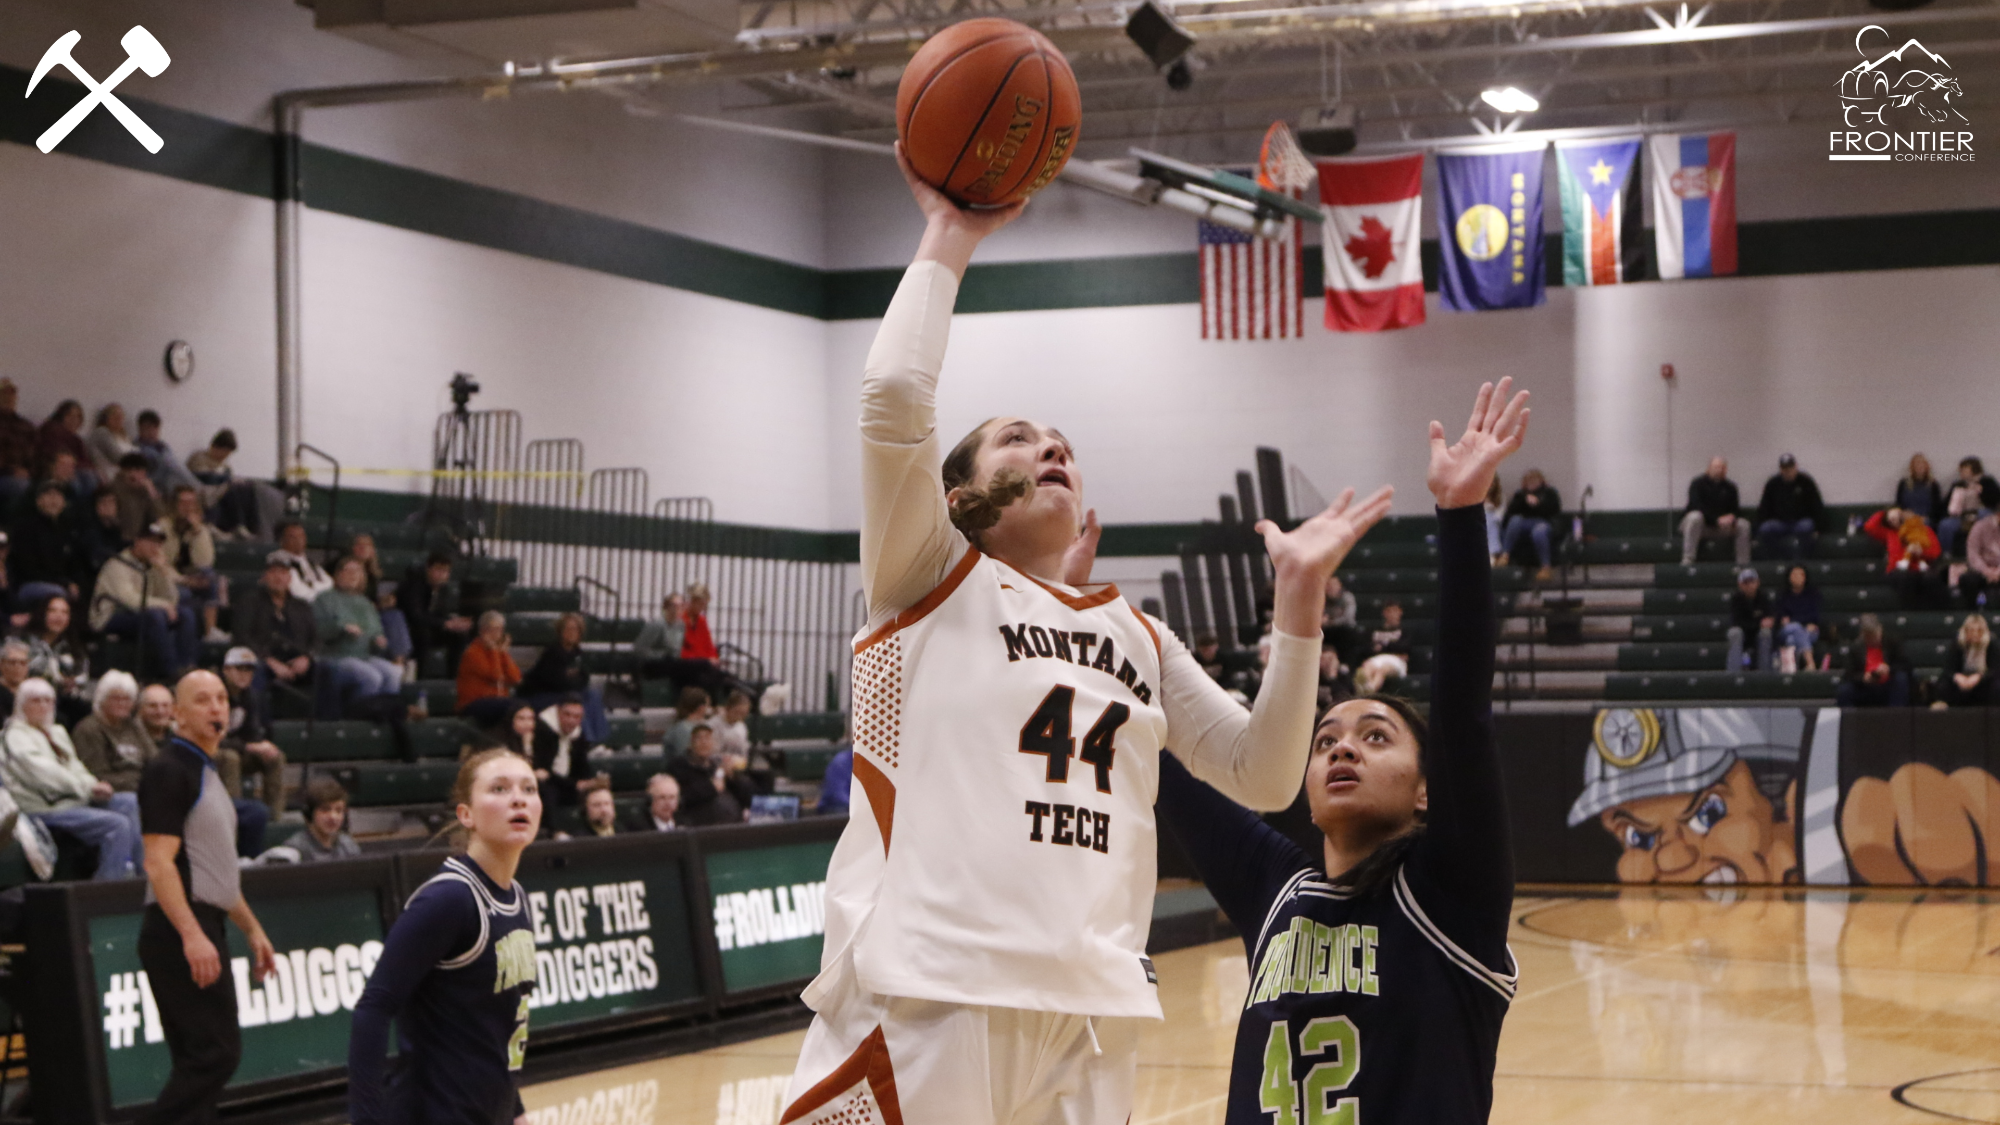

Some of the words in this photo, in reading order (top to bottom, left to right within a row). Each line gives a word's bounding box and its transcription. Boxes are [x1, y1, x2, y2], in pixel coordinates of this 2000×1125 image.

[964, 93, 1043, 200] PALDING
[1018, 683, 1130, 795] 44
[1025, 800, 1110, 854] TECH
[554, 886, 590, 941] OF
[593, 880, 651, 935] THE
[527, 935, 659, 1009] DIGGERS
[1259, 1015, 1360, 1125] 42
